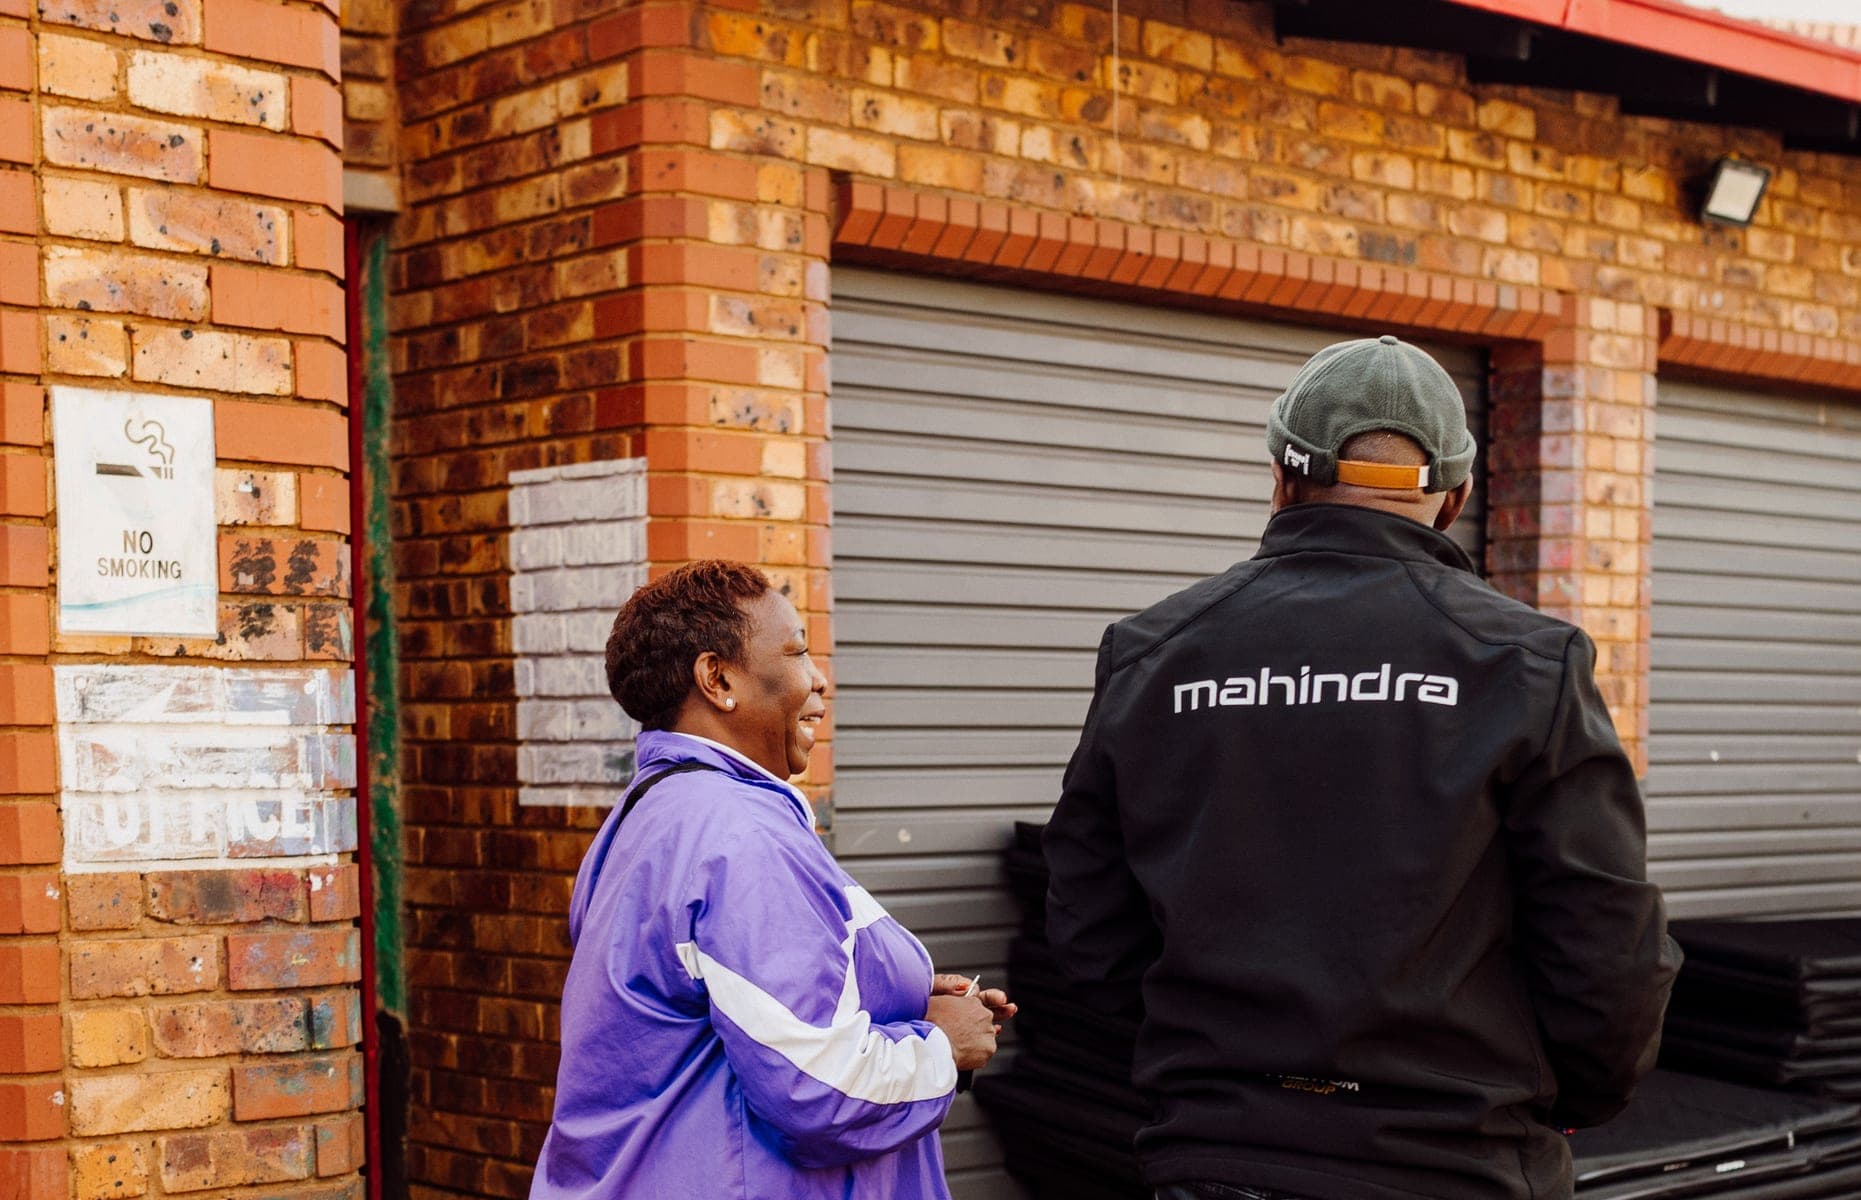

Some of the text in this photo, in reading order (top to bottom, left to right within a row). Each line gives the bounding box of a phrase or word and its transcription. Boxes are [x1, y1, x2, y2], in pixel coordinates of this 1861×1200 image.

[123, 530, 153, 554] NO
[97, 557, 182, 579] SMOKING
[1174, 663, 1459, 714] mahindra
